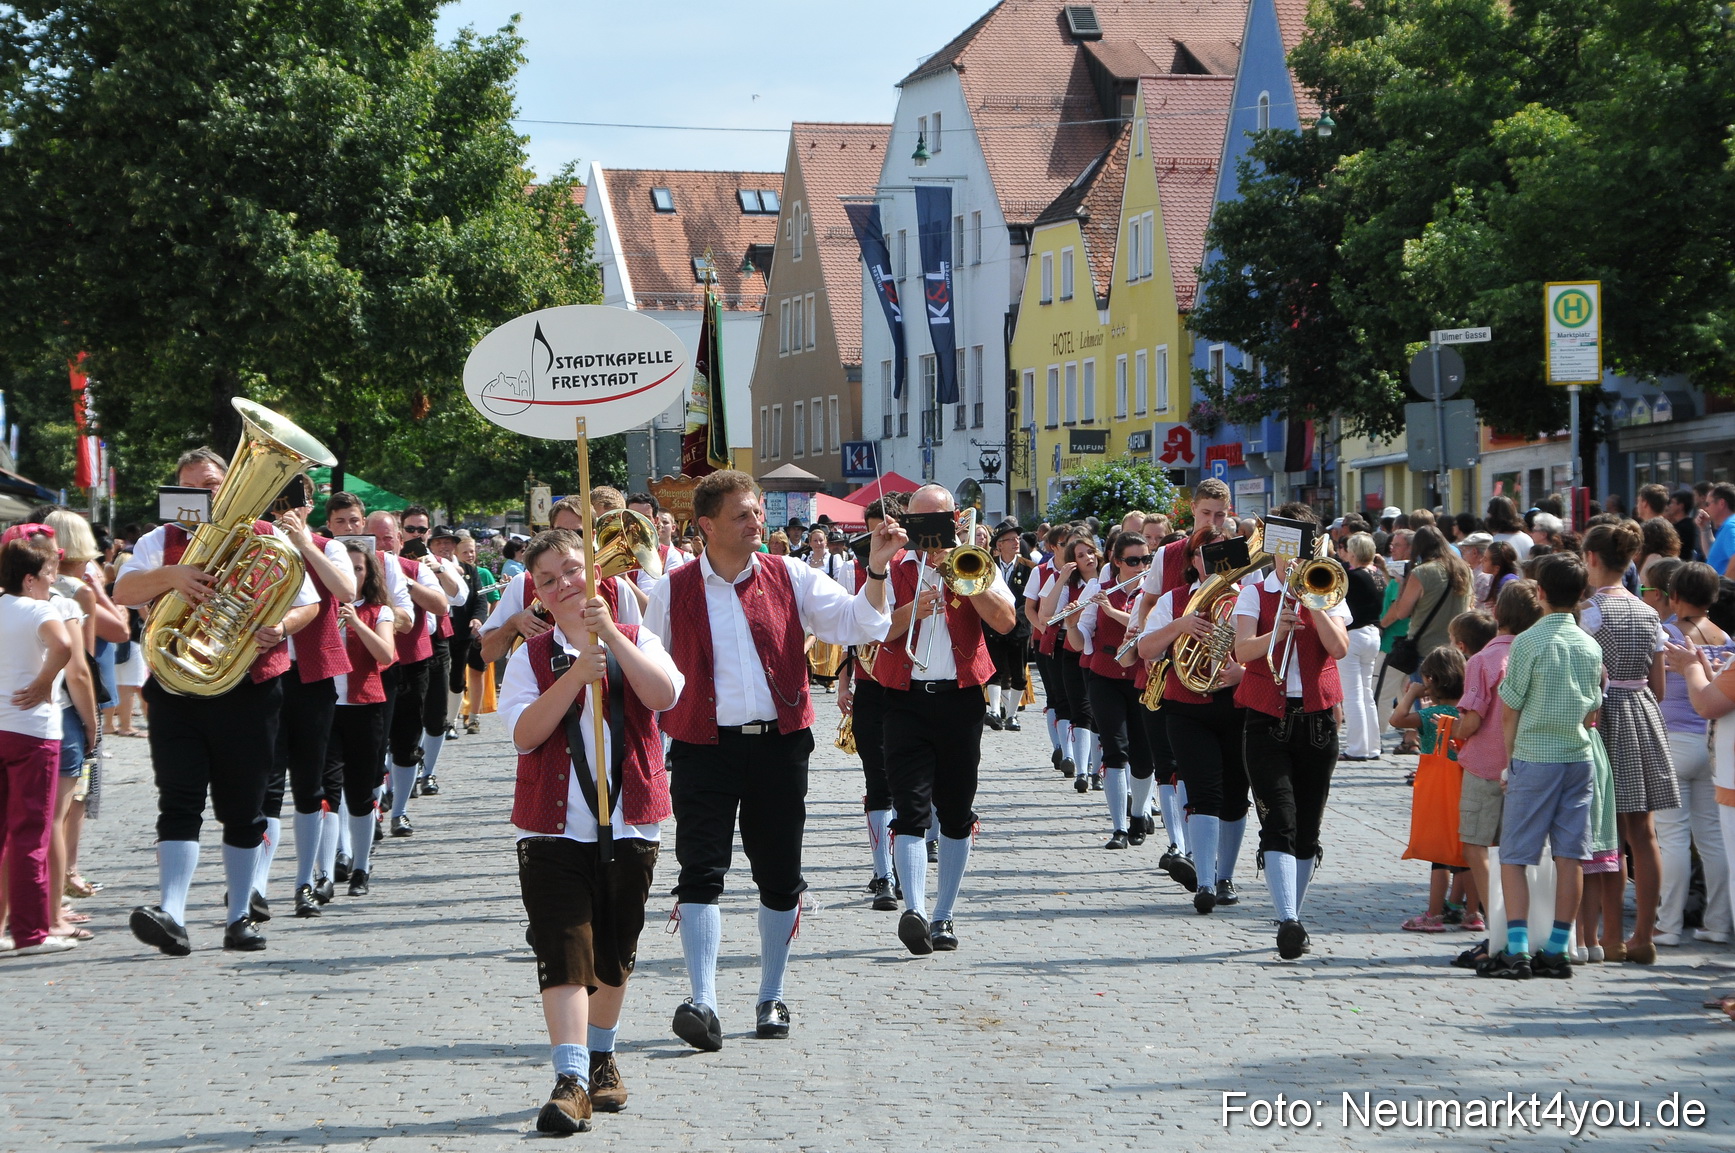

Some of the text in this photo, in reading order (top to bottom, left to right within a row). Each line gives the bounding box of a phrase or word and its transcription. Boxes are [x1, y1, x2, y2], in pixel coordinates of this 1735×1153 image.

[1052, 330, 1075, 356] HOTEL
[1441, 330, 1487, 341] Ulmer Gasse
[1557, 331, 1591, 339] Marktplatz
[555, 350, 674, 370] STADTKAPELLE
[551, 371, 639, 390] FREYSTADT
